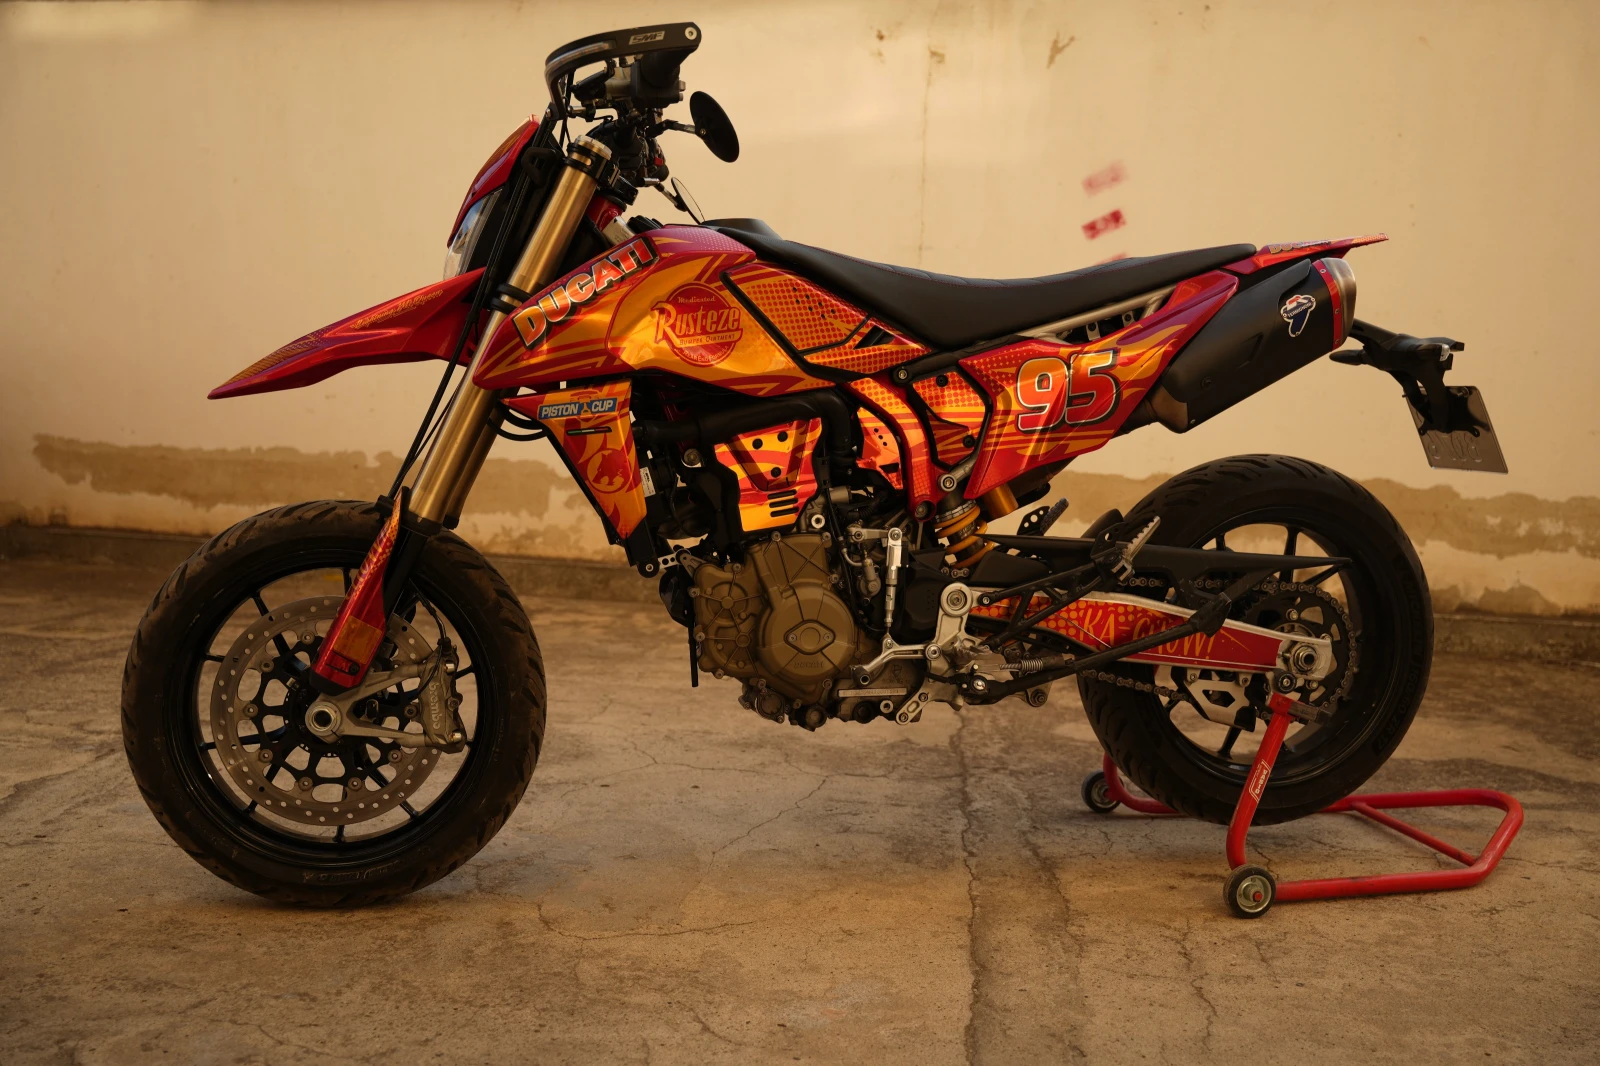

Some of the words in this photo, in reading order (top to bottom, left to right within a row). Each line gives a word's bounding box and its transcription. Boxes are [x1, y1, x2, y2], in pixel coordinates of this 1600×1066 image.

[513, 238, 656, 348] DUCATI
[677, 295, 716, 304] Medicated
[652, 301, 741, 345] Rust-eze
[541, 402, 579, 418] PISTON
[591, 399, 614, 413] CUP
[1016, 349, 1119, 432] 95
[429, 682, 443, 730] brembo
